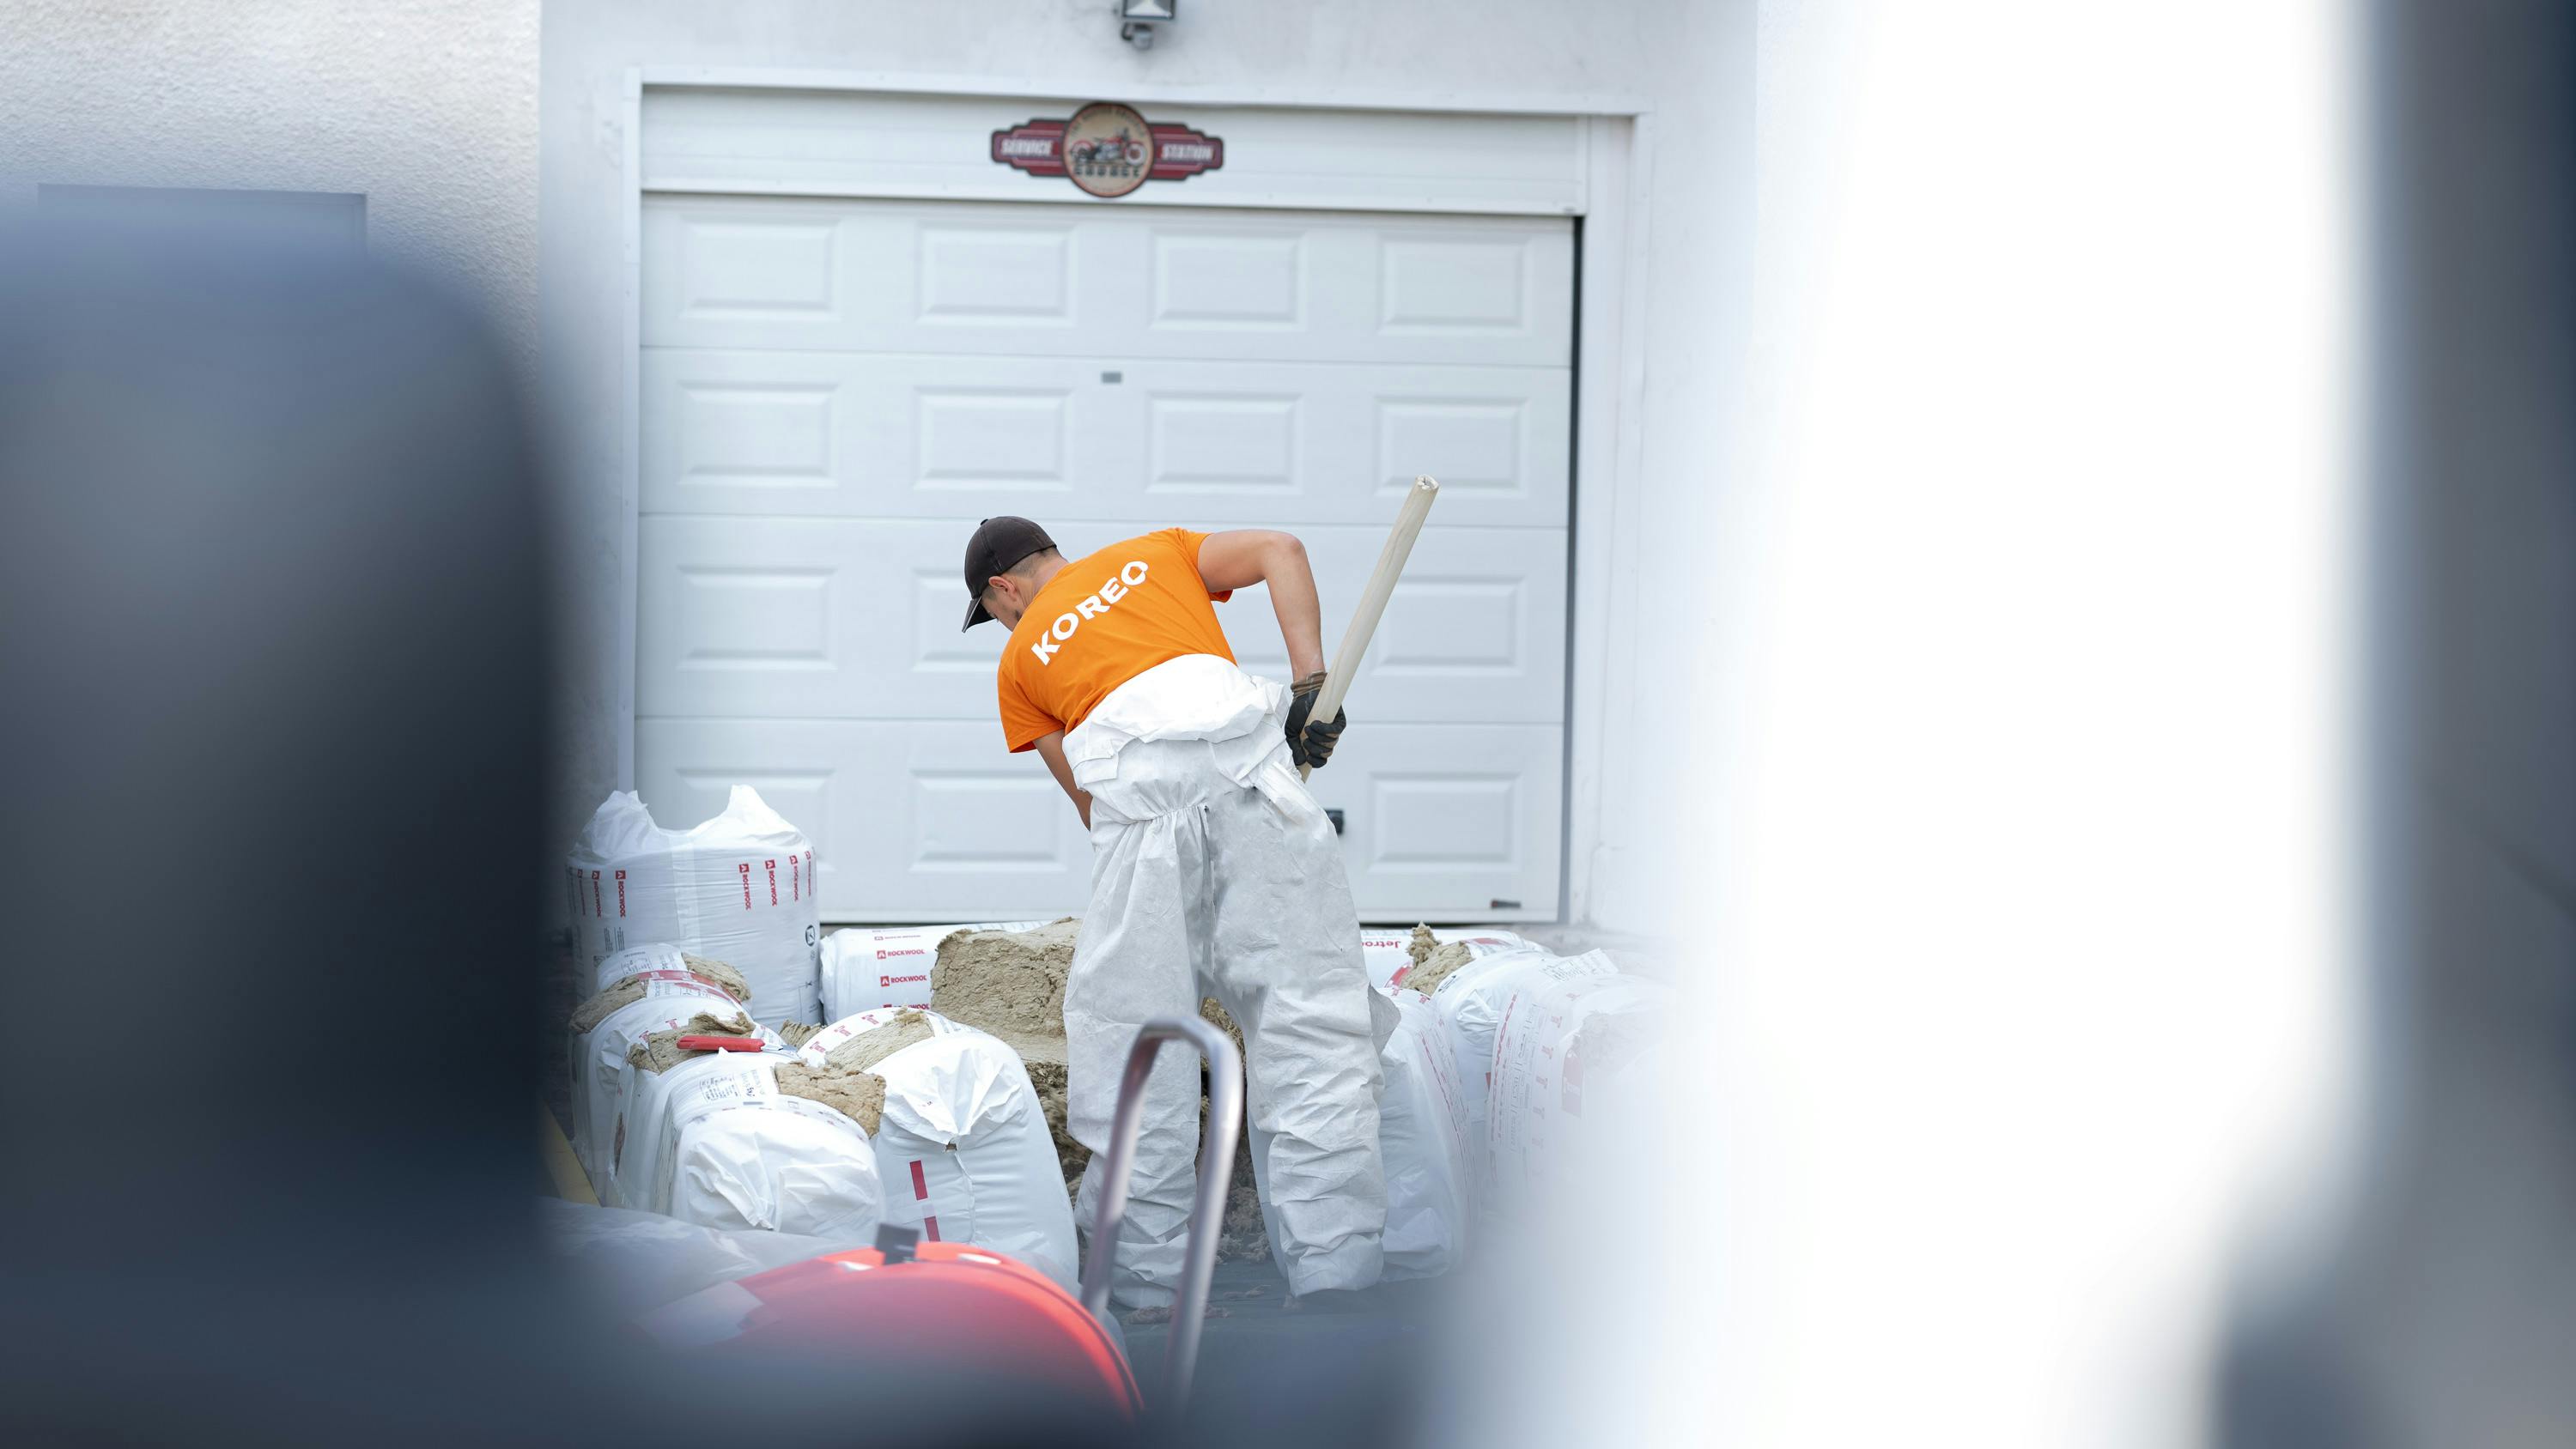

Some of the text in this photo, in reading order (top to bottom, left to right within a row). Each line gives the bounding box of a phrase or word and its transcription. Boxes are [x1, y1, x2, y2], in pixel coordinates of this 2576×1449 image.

[1000, 138, 1215, 161] SERVICE STATION
[1031, 561, 1149, 665] KOREO
[617, 881, 626, 918] ROCKWOOL
[743, 874, 751, 911] ROCKWOOL
[769, 870, 777, 906] ROCKWOOL
[890, 975, 927, 984] ROCKWOOL
